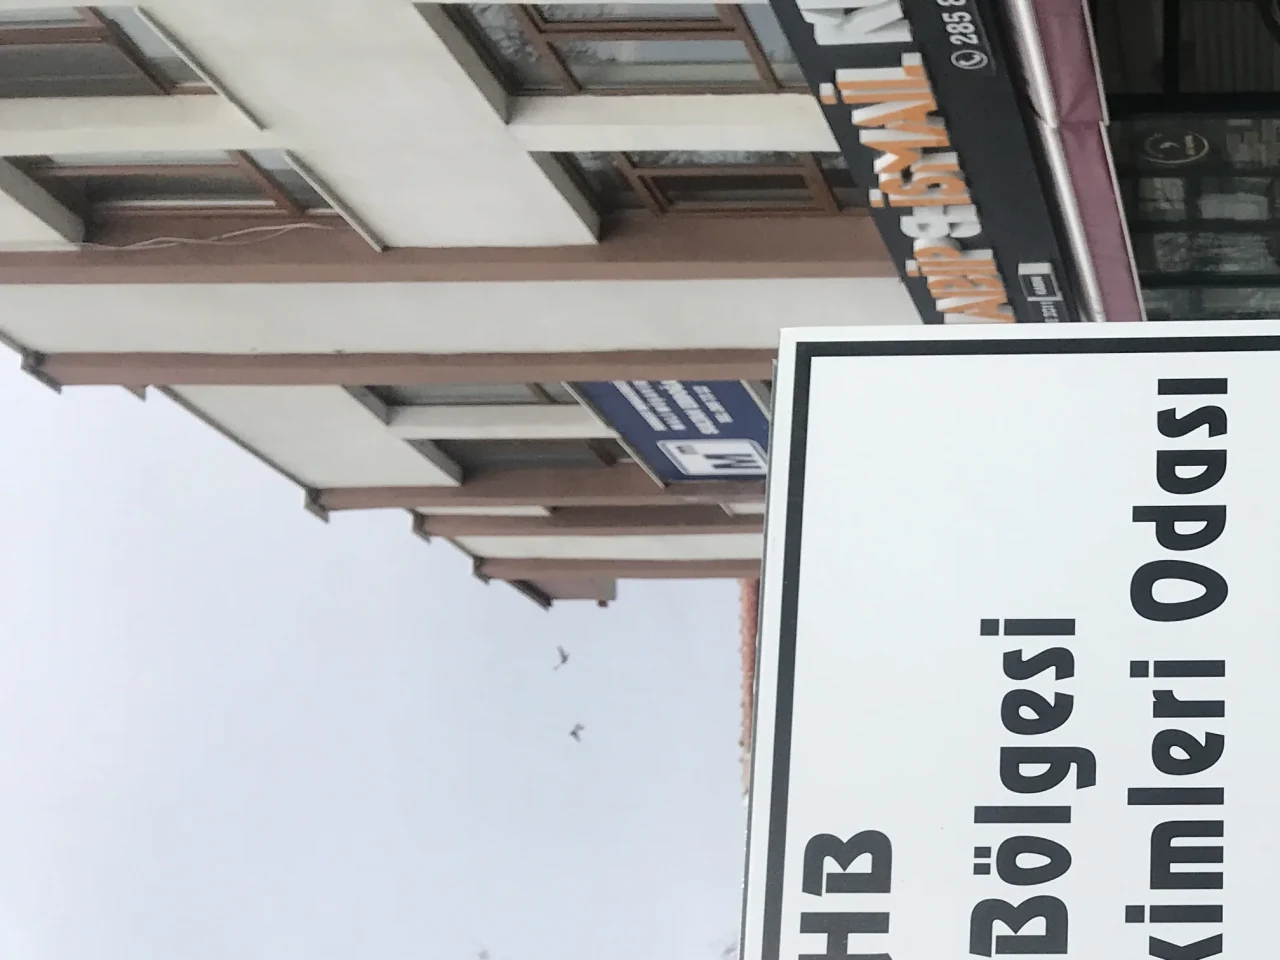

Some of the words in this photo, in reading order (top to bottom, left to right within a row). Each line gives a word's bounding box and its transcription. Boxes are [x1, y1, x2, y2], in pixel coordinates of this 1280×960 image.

[942, 11, 979, 45] 285
[819, 53, 972, 208] İSMAİL
[905, 238, 1016, 324] ABİP
[1130, 378, 1228, 623] Odası
[969, 619, 1096, 958] Bölgesi
